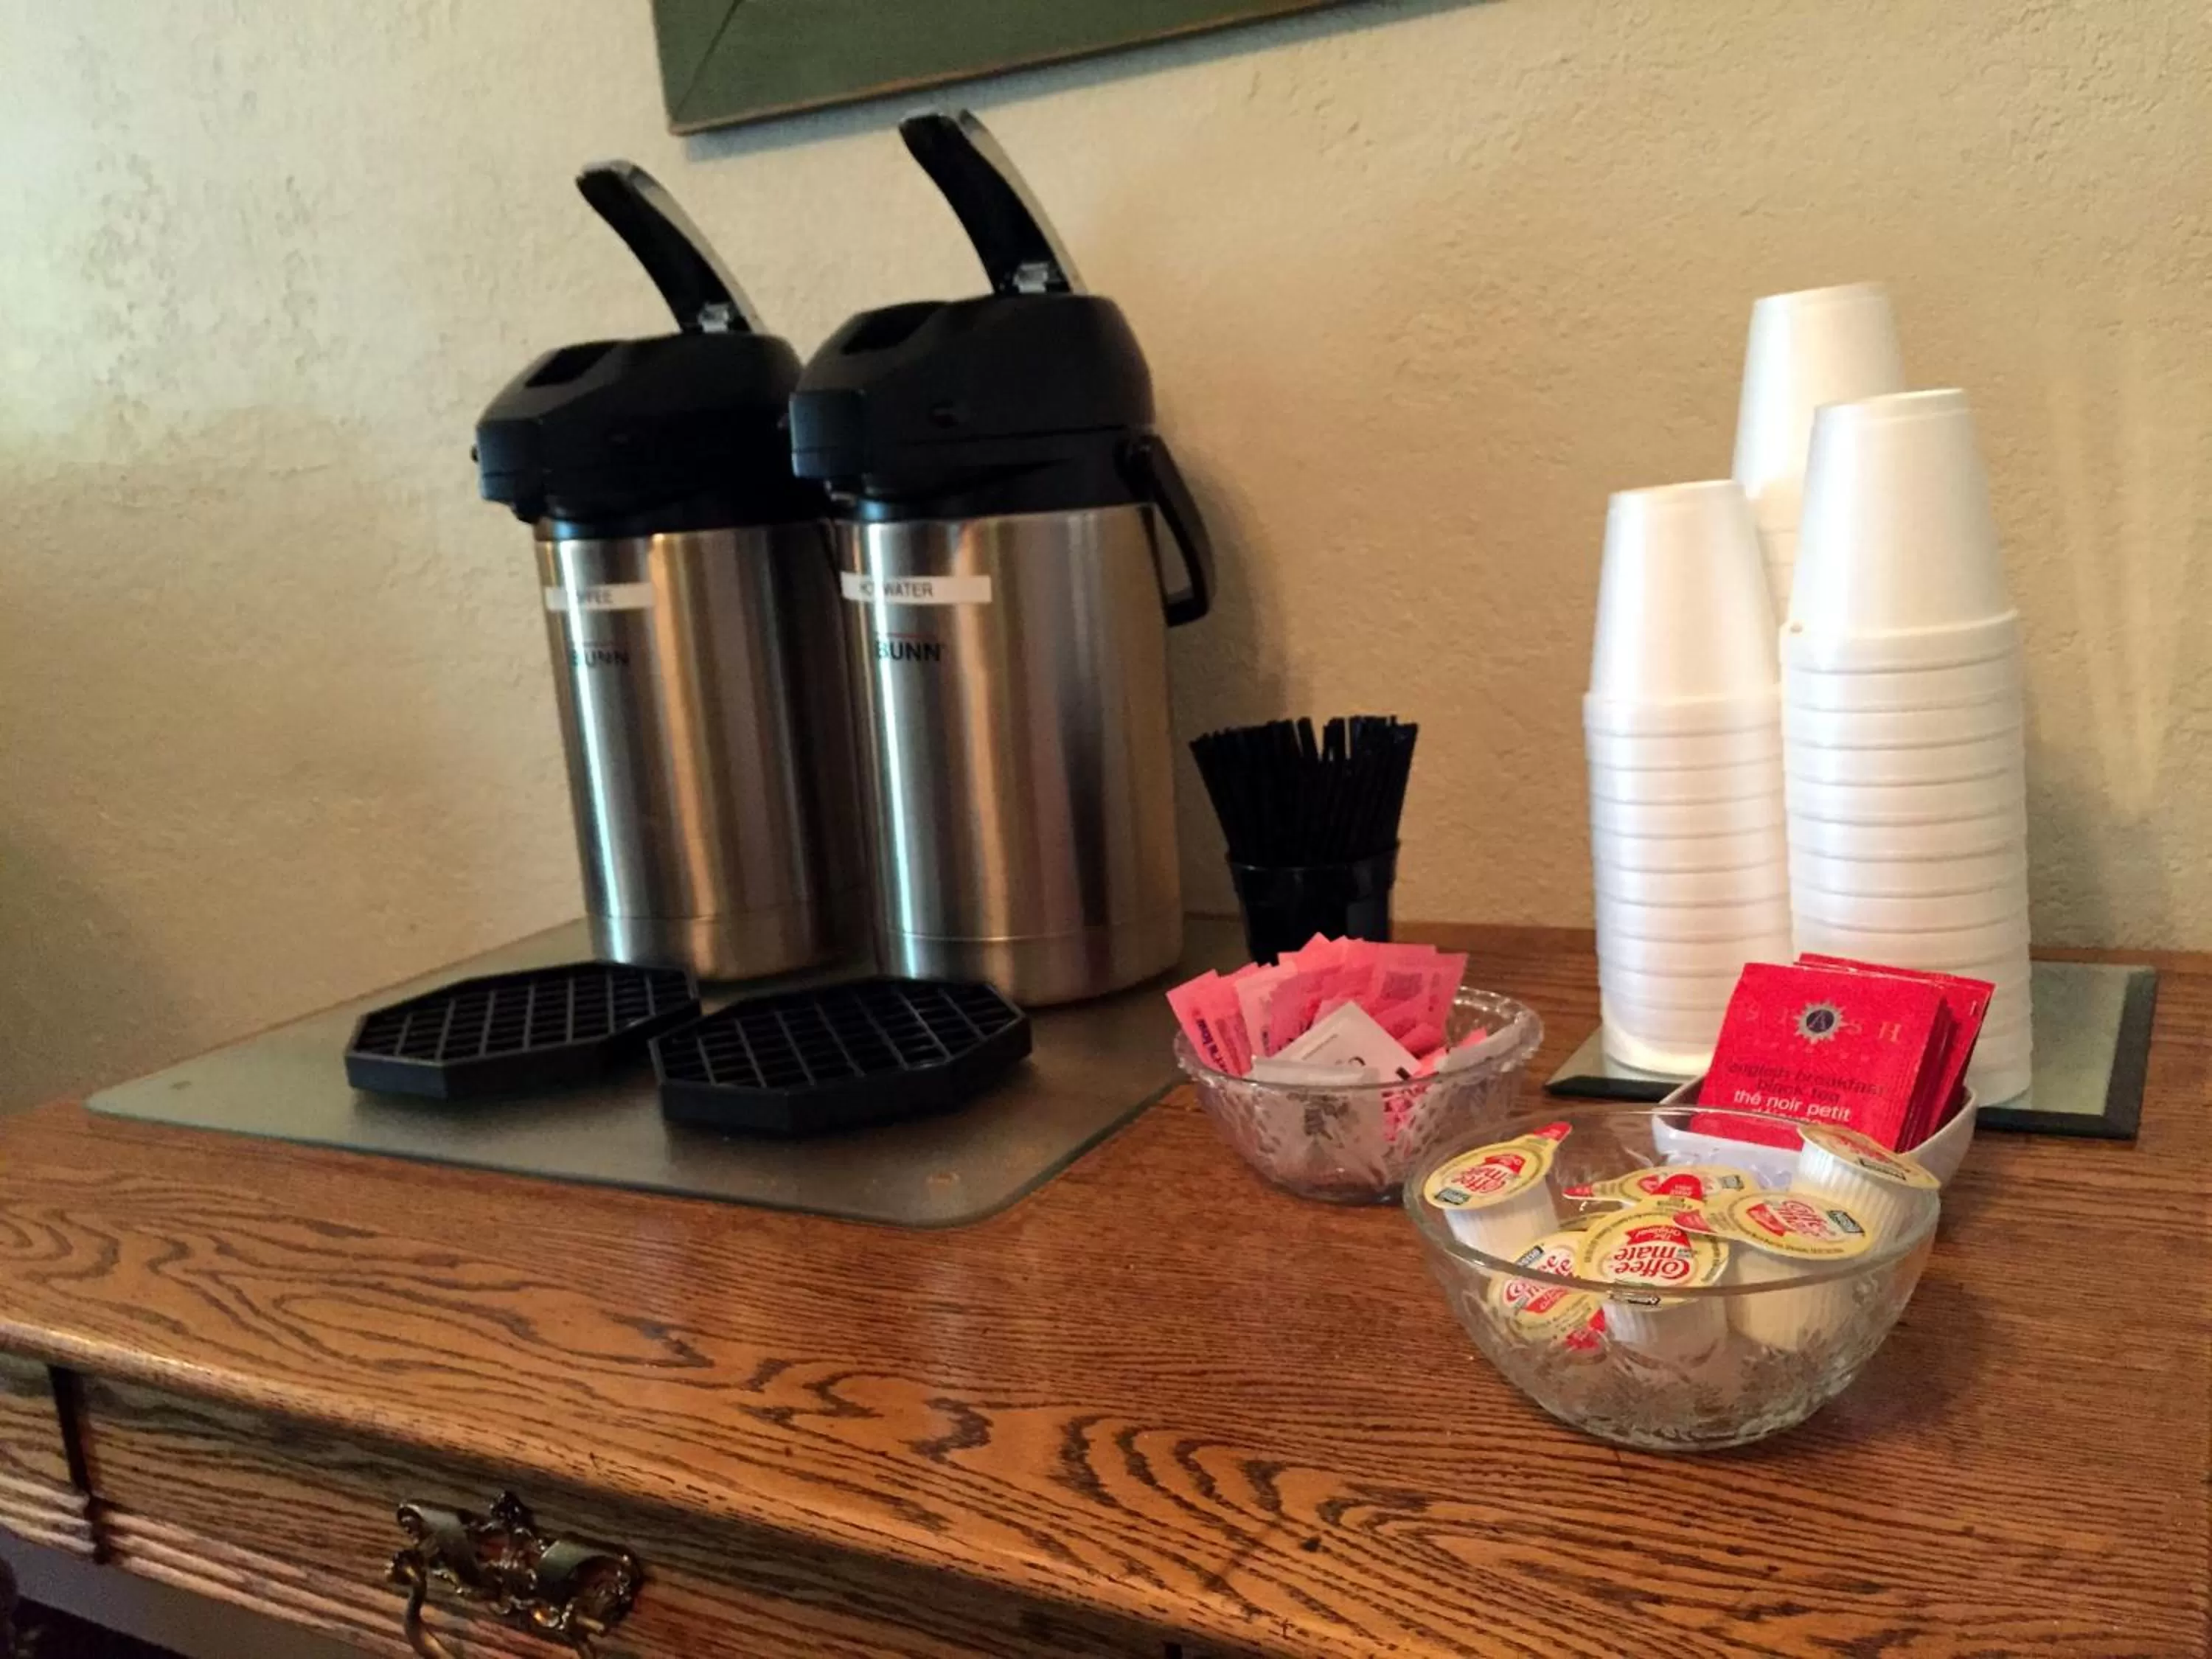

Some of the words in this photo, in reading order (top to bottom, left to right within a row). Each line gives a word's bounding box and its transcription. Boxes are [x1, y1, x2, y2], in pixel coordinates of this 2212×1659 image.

[883, 581, 933, 597] WATER
[876, 640, 940, 661] BUNN
[1766, 1096, 1803, 1112] noir
[1806, 1103, 1852, 1121] petit
[1614, 1245, 1677, 1262] mate
